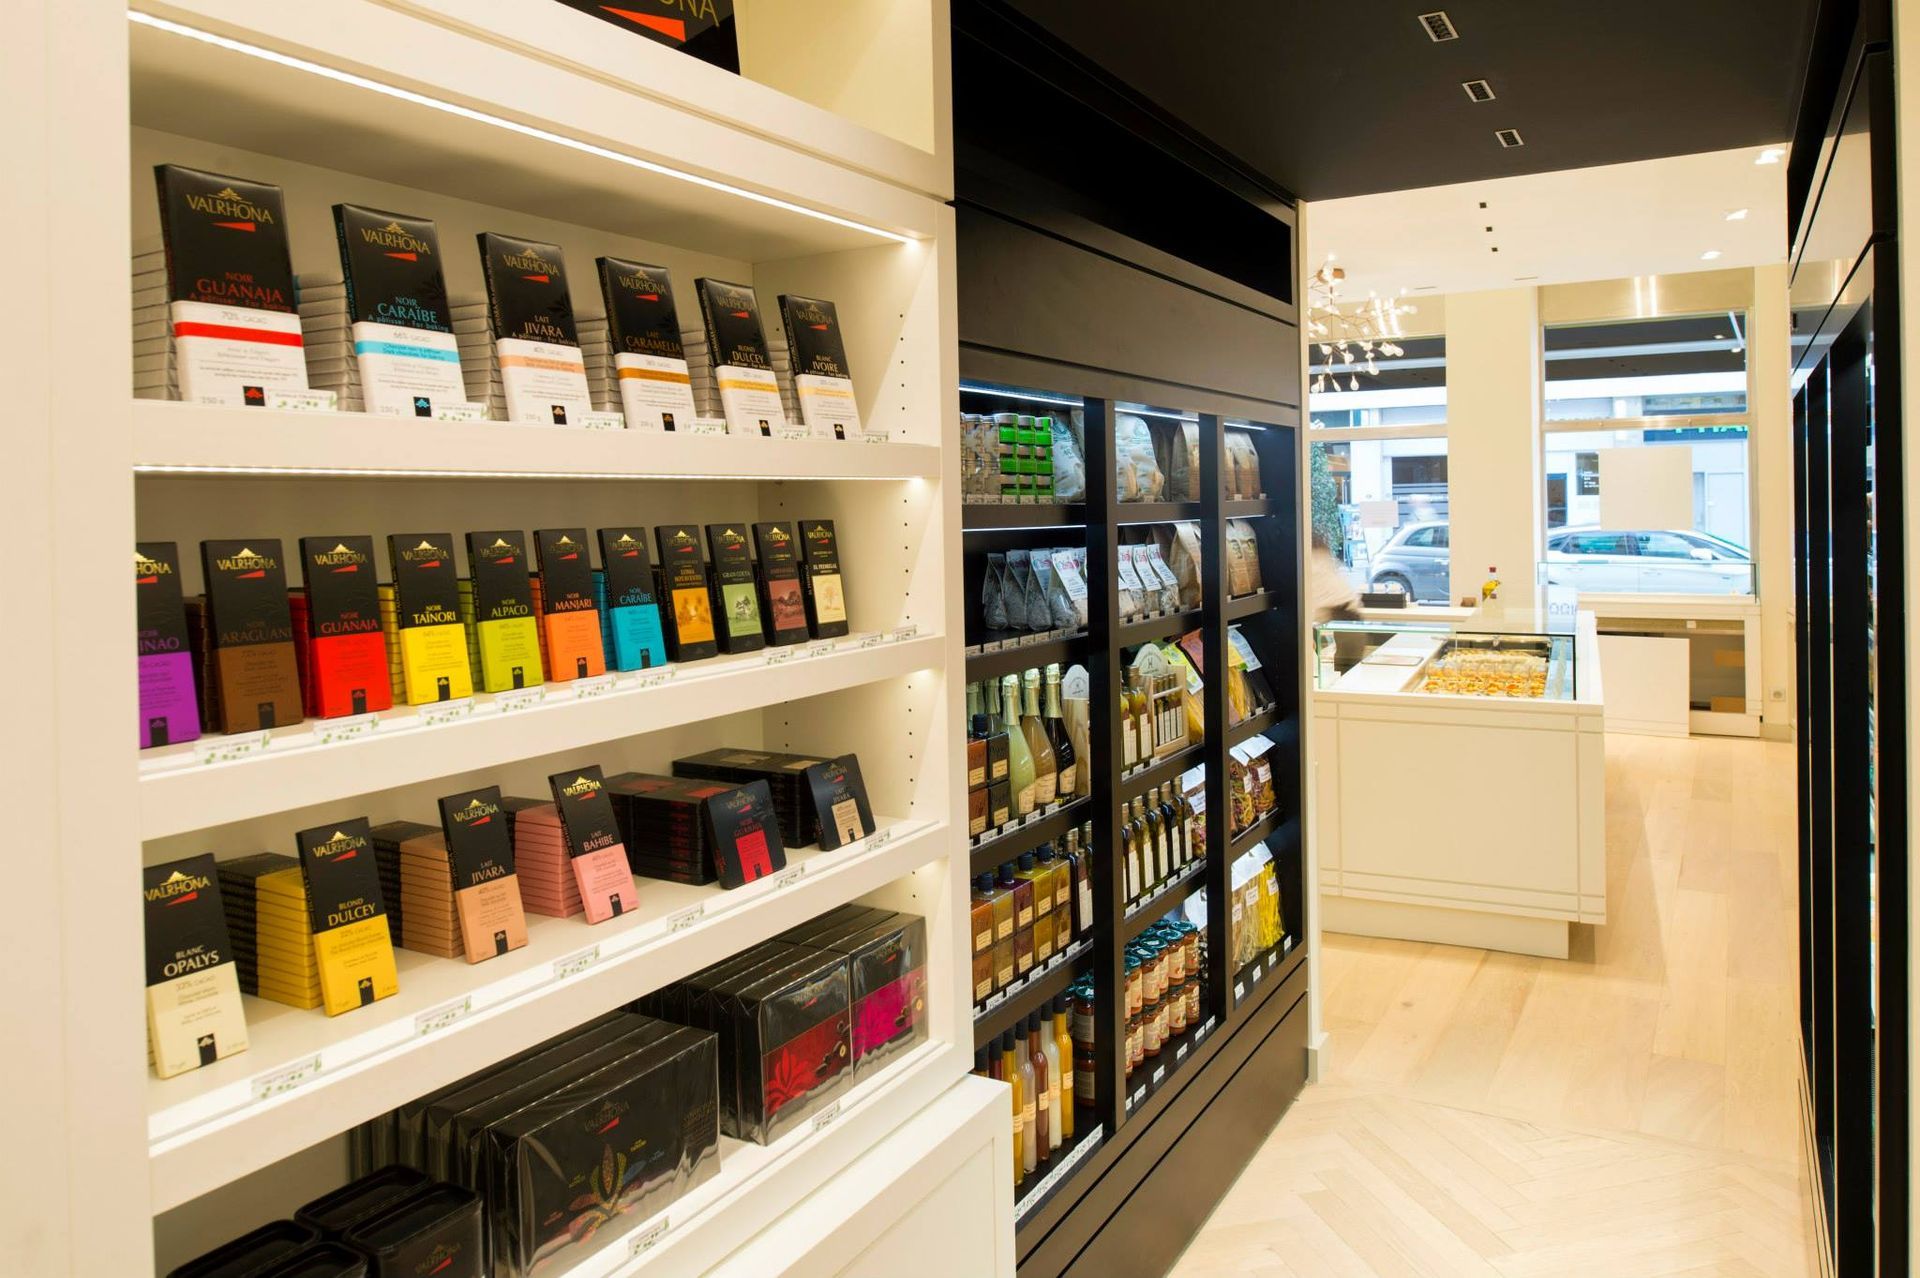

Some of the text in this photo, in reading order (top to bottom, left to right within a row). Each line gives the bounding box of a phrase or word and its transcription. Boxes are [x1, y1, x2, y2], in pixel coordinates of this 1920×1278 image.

[660, 0, 720, 27] NA
[186, 193, 274, 224] VALRHONA
[361, 228, 431, 254] VALRHONA
[503, 254, 560, 276] VALRHONA
[226, 272, 254, 283] NOIR
[619, 275, 668, 296] VALRHONA
[196, 278, 283, 303] GUANAJA
[395, 296, 418, 306] NOIR
[377, 303, 438, 323] CARAÏBE
[534, 315, 550, 323] LAIT
[524, 321, 564, 338] JIVARA
[731, 350, 764, 365] DULCEY
[812, 360, 839, 373] IVOIRE
[217, 558, 276, 571] VALRHONA
[314, 552, 368, 566] VALRHONA
[491, 605, 529, 618] ALPACO
[555, 599, 593, 612] MANJARI
[321, 619, 379, 634] GUANAJA
[412, 611, 457, 625] TAÏNORI
[563, 781, 602, 798] VALRHONA
[453, 804, 499, 824] VALRHONA
[312, 836, 367, 859] VALRHONA
[583, 833, 615, 852] BAHIBE
[471, 864, 506, 885] JIVARA
[144, 875, 212, 902] VALRHONA
[338, 897, 364, 911] BLOND
[327, 903, 377, 927] DULCEY
[176, 945, 205, 960] BLANC
[163, 951, 220, 978] OPALYS
